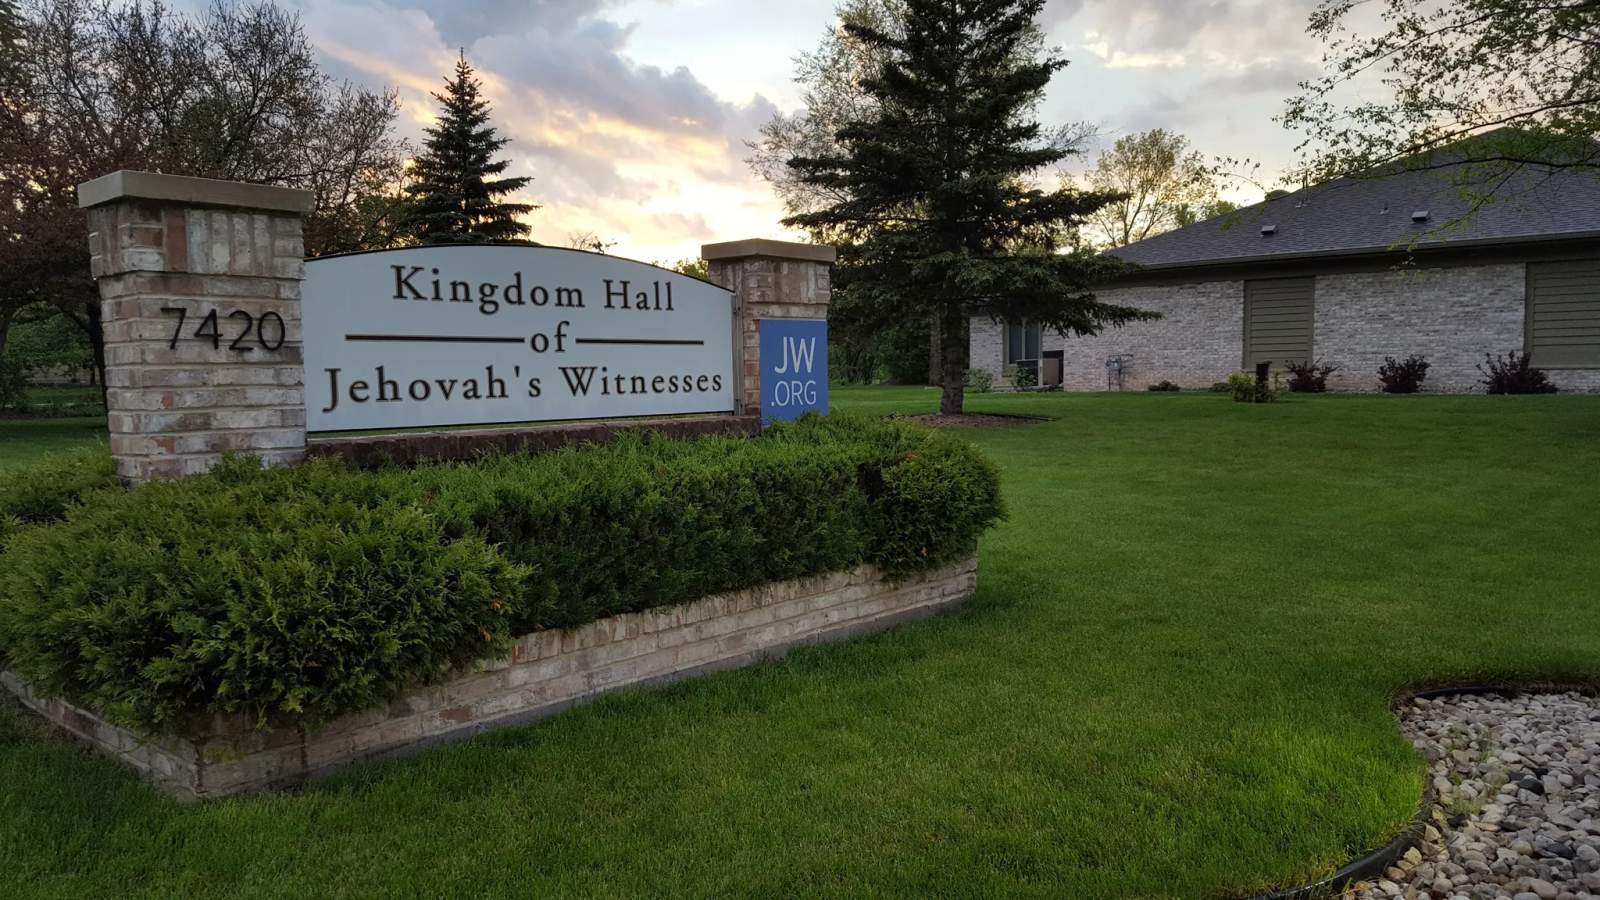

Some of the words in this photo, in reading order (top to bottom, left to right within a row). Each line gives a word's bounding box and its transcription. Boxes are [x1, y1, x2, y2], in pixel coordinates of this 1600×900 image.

[390, 264, 586, 316] Kingdom
[602, 279, 675, 312] Hall
[160, 307, 286, 352] 7420
[530, 320, 571, 354] of
[774, 336, 816, 374] JW
[322, 364, 541, 413] Jehovah's
[558, 366, 722, 397] Witnesses
[771, 380, 817, 407] .ORG
